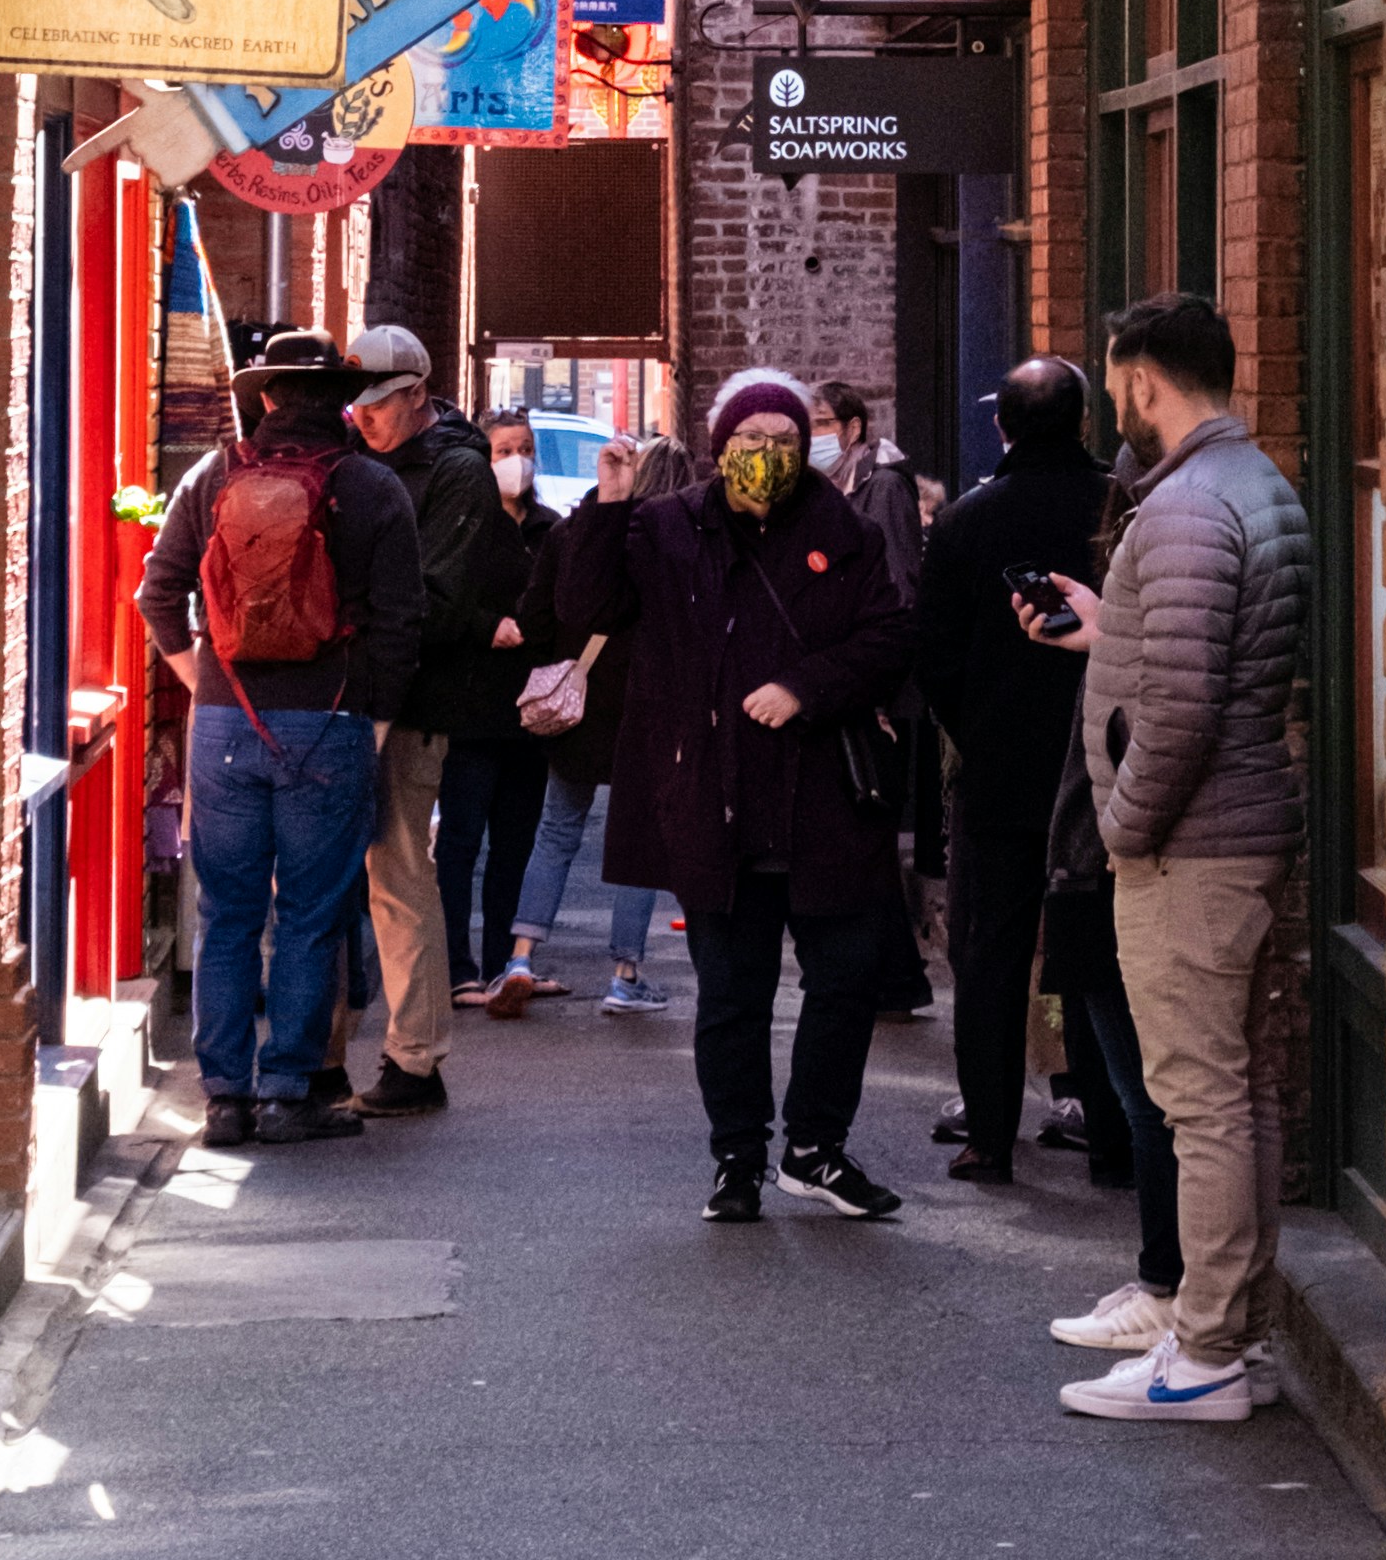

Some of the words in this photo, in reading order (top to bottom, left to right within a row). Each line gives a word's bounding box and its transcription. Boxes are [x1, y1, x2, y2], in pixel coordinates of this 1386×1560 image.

[9, 26, 120, 45] CELEBRATING
[129, 32, 161, 47] THE
[170, 35, 234, 51] SACRED
[243, 38, 297, 55] EARTH
[419, 83, 509, 115] Arts
[769, 116, 898, 135] SALTSPRING
[769, 141, 907, 160] SOAPWORKS
[214, 149, 246, 192] erbs,
[344, 151, 386, 184] Teas
